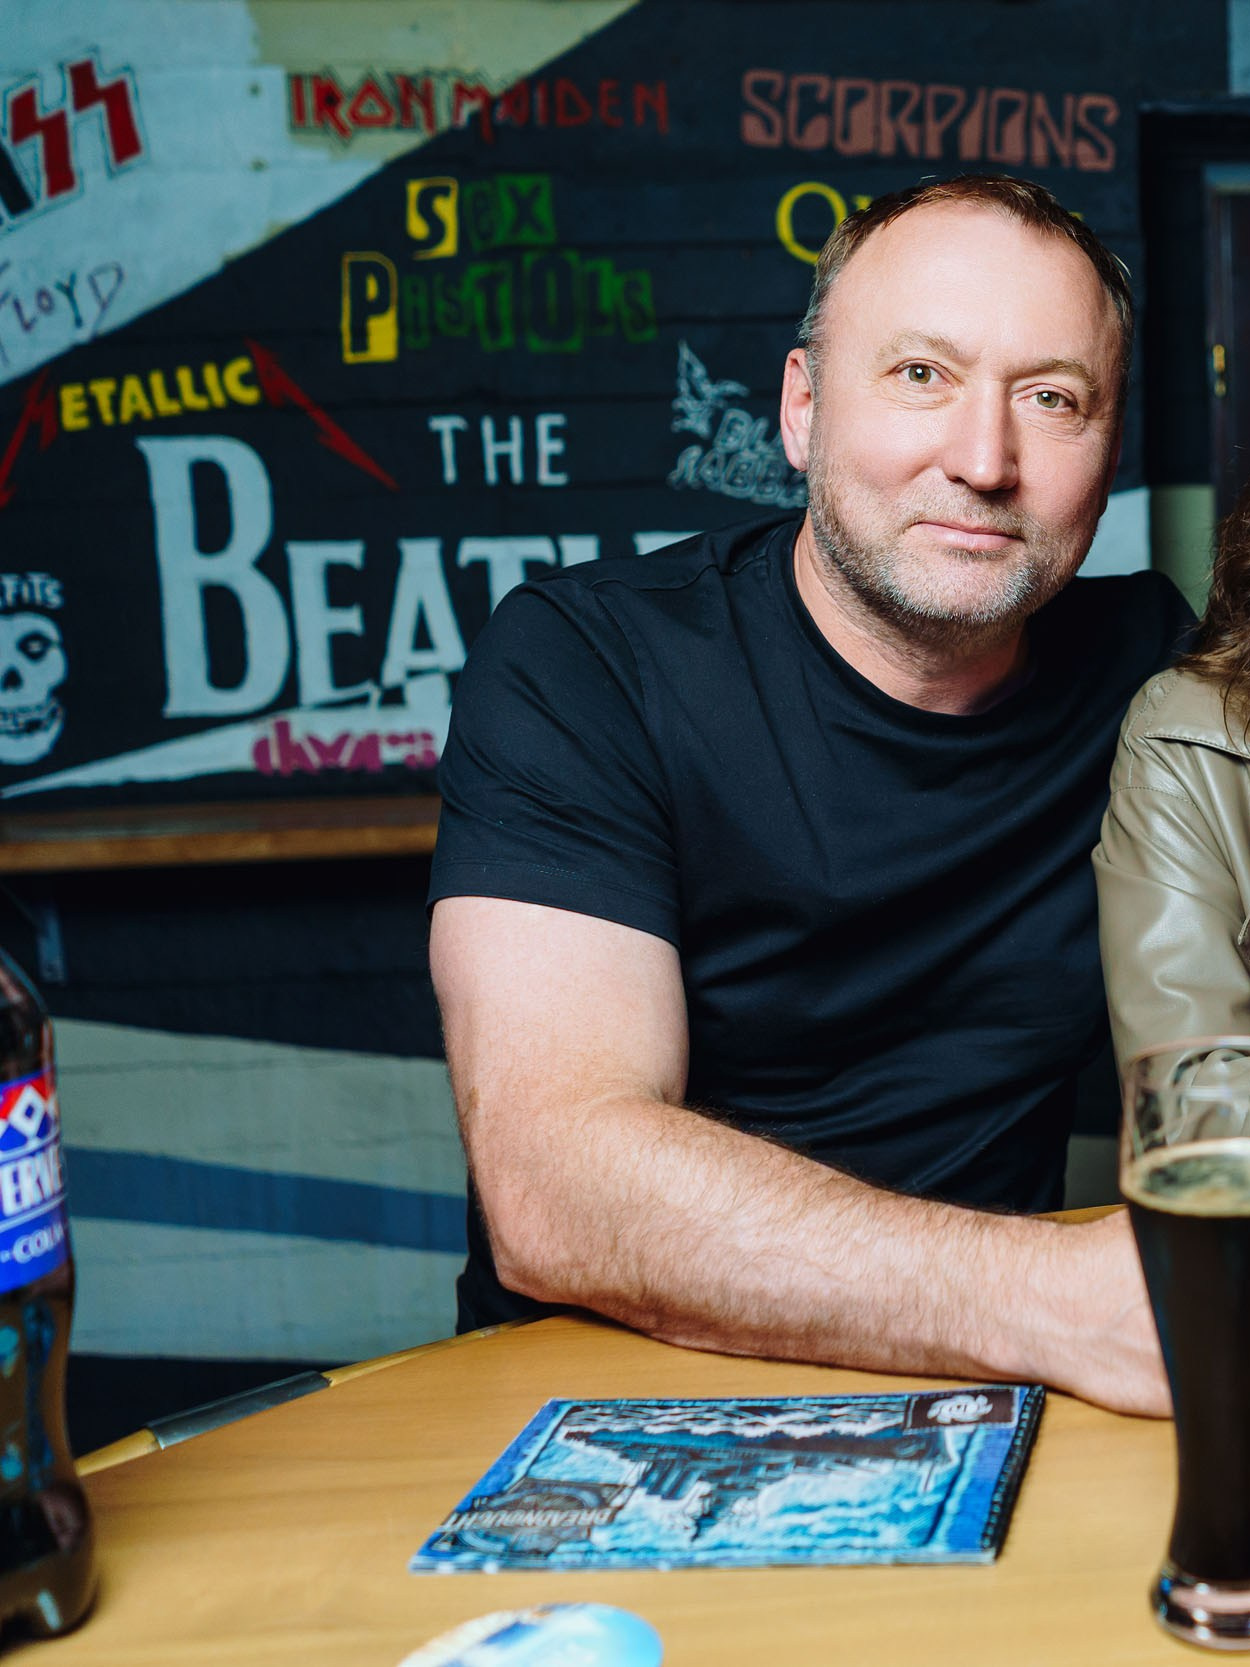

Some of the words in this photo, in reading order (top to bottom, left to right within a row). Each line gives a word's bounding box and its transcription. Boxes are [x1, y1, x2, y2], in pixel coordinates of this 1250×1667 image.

[290, 73, 437, 139] IRON
[450, 76, 669, 145] MAIDEN
[741, 68, 1118, 171] SCORPIONS
[428, 412, 570, 487] THE
